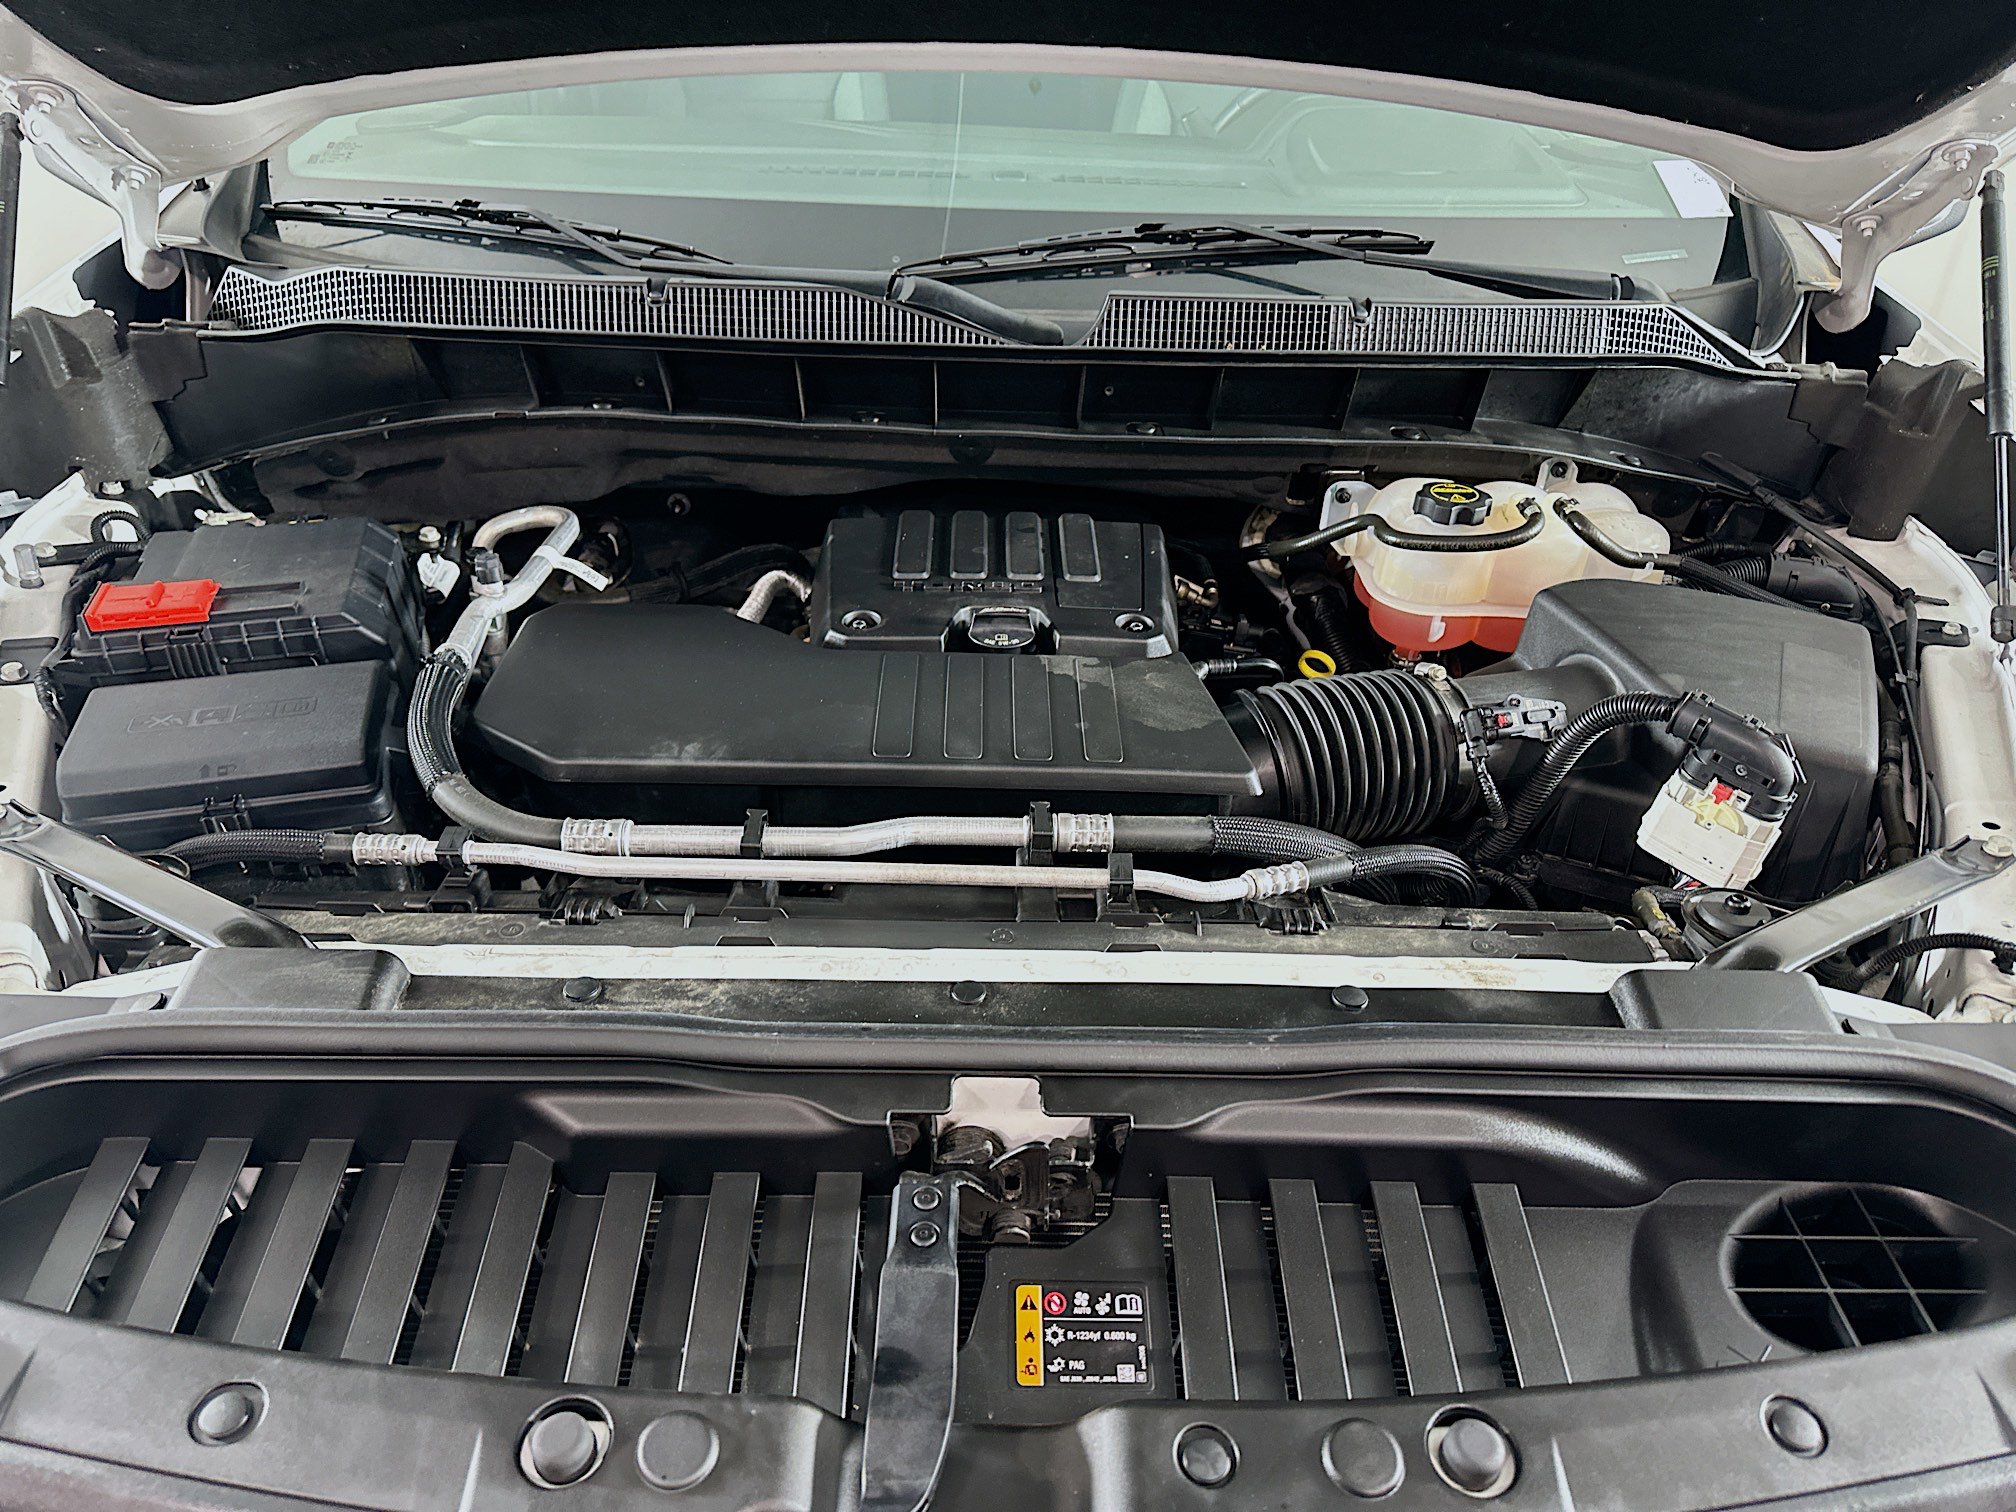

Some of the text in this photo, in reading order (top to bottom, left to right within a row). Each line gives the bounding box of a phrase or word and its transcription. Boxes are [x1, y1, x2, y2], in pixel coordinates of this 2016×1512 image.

[1073, 1306, 1091, 1315] AUTO
[1067, 1331, 1101, 1342] R-1234yf
[1126, 1331, 1137, 1342] kg
[1068, 1360, 1085, 1371] PAG
